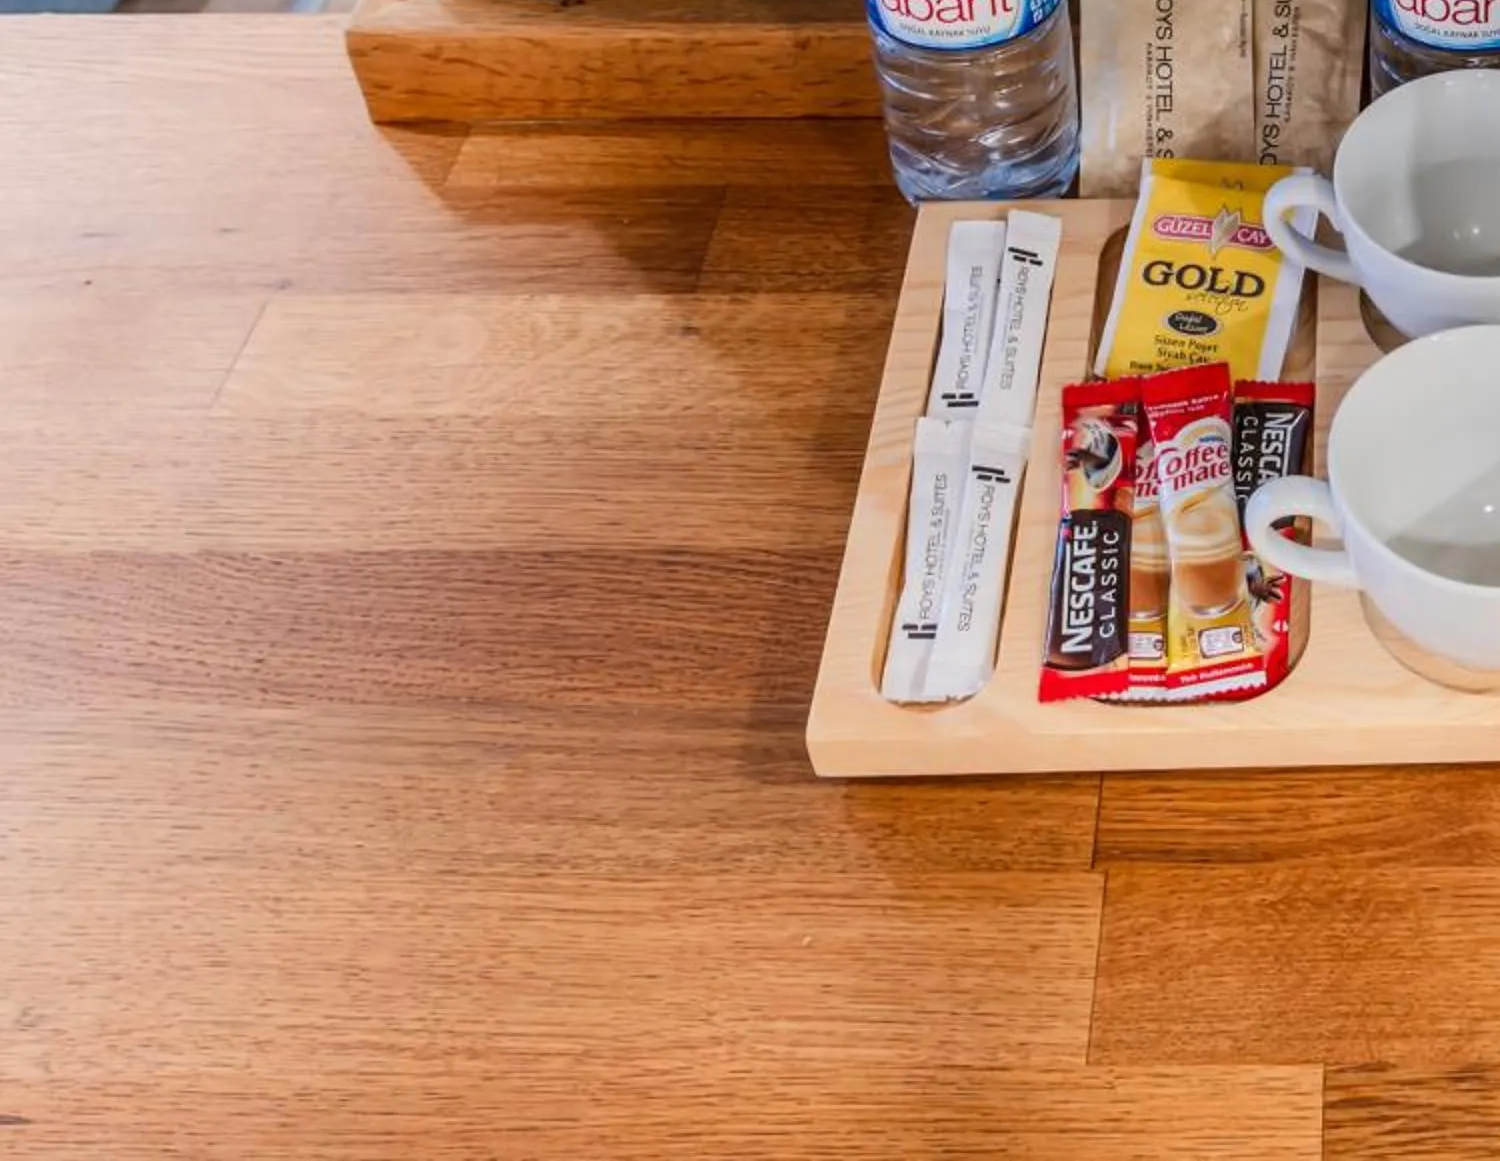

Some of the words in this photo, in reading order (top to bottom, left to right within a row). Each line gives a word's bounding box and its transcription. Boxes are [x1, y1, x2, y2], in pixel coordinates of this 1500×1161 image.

[1273, 22, 1289, 38] &
[1155, 46, 1173, 120] HOTEL
[1265, 45, 1288, 119] HOTEL
[1155, 128, 1174, 142] &
[1260, 123, 1280, 166] OYS
[1158, 217, 1211, 236] GÜZEL
[1142, 260, 1265, 297] GOLD
[1172, 461, 1230, 492] mate
[1100, 532, 1120, 638] CLASSIC
